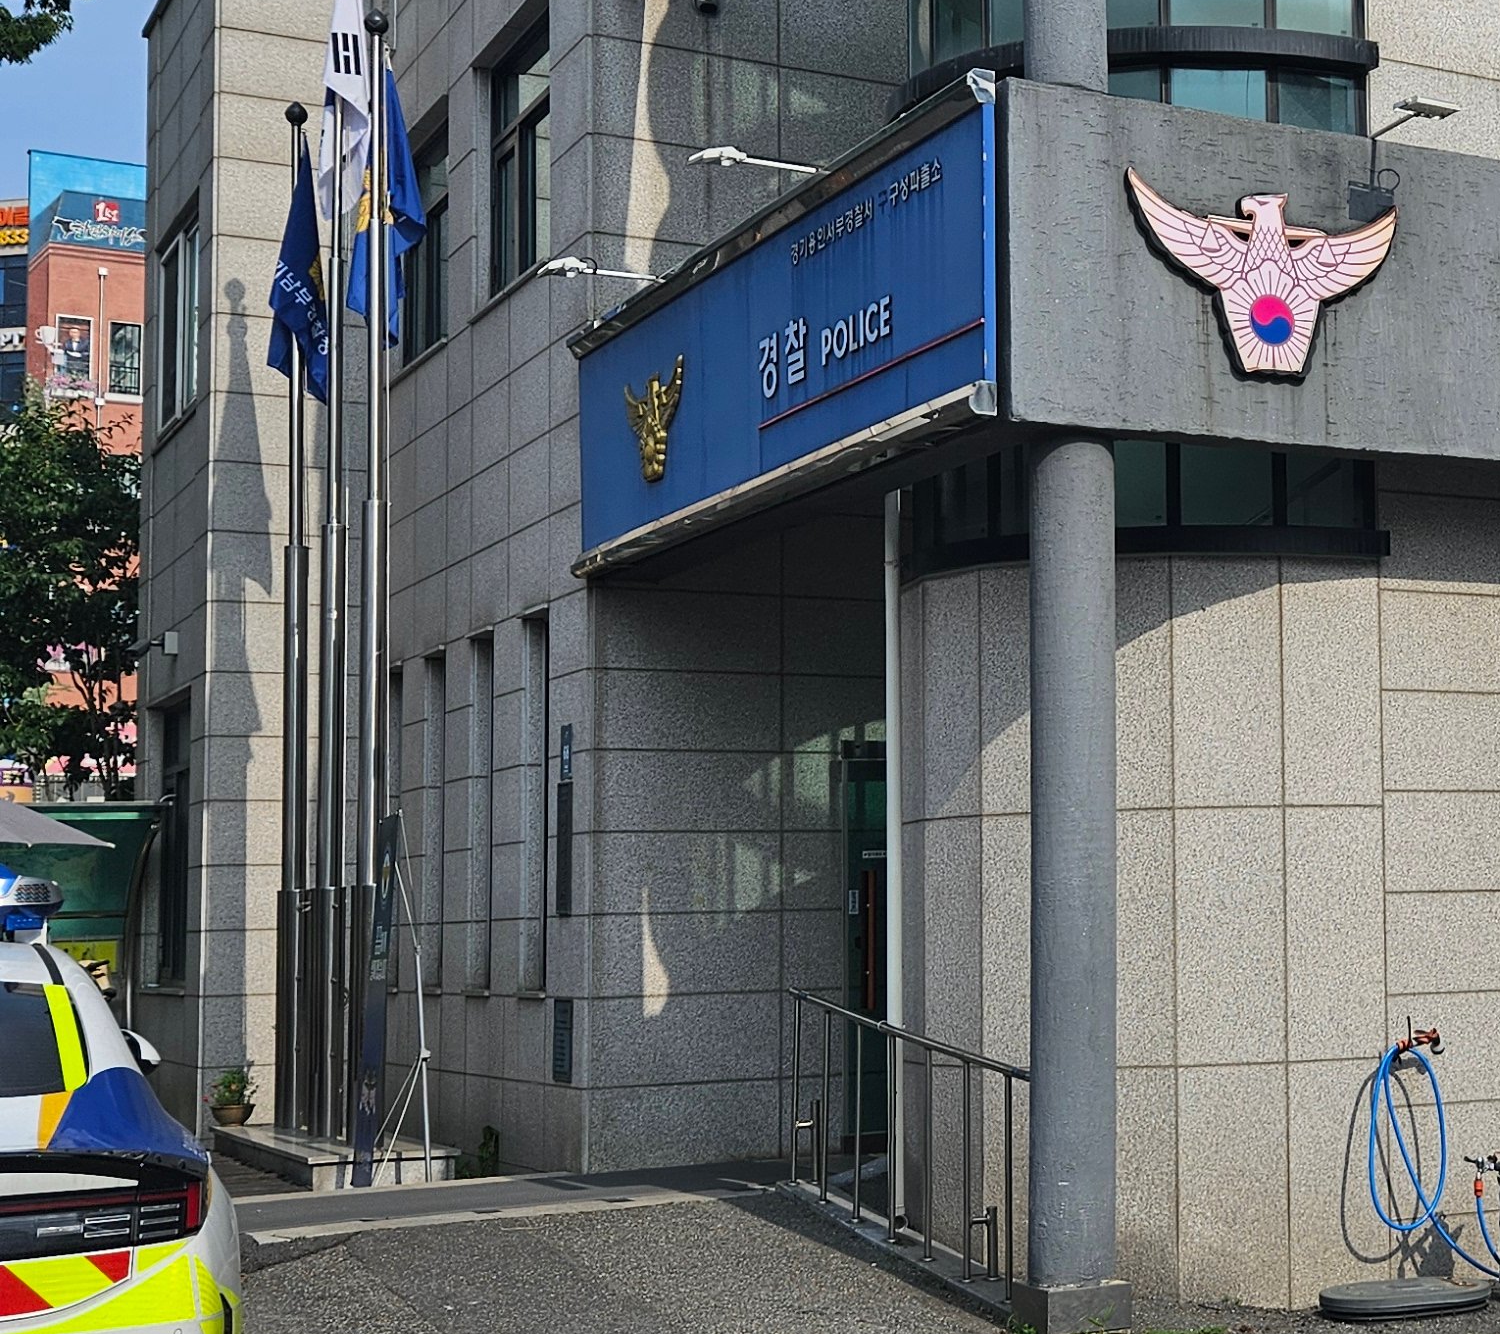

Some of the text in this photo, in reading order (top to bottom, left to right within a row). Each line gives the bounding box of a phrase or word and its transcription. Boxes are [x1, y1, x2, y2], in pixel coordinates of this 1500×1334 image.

[790, 157, 943, 266] 경기용인서부경찰서 구성파출소
[758, 295, 891, 399] 경찰 POLICE
